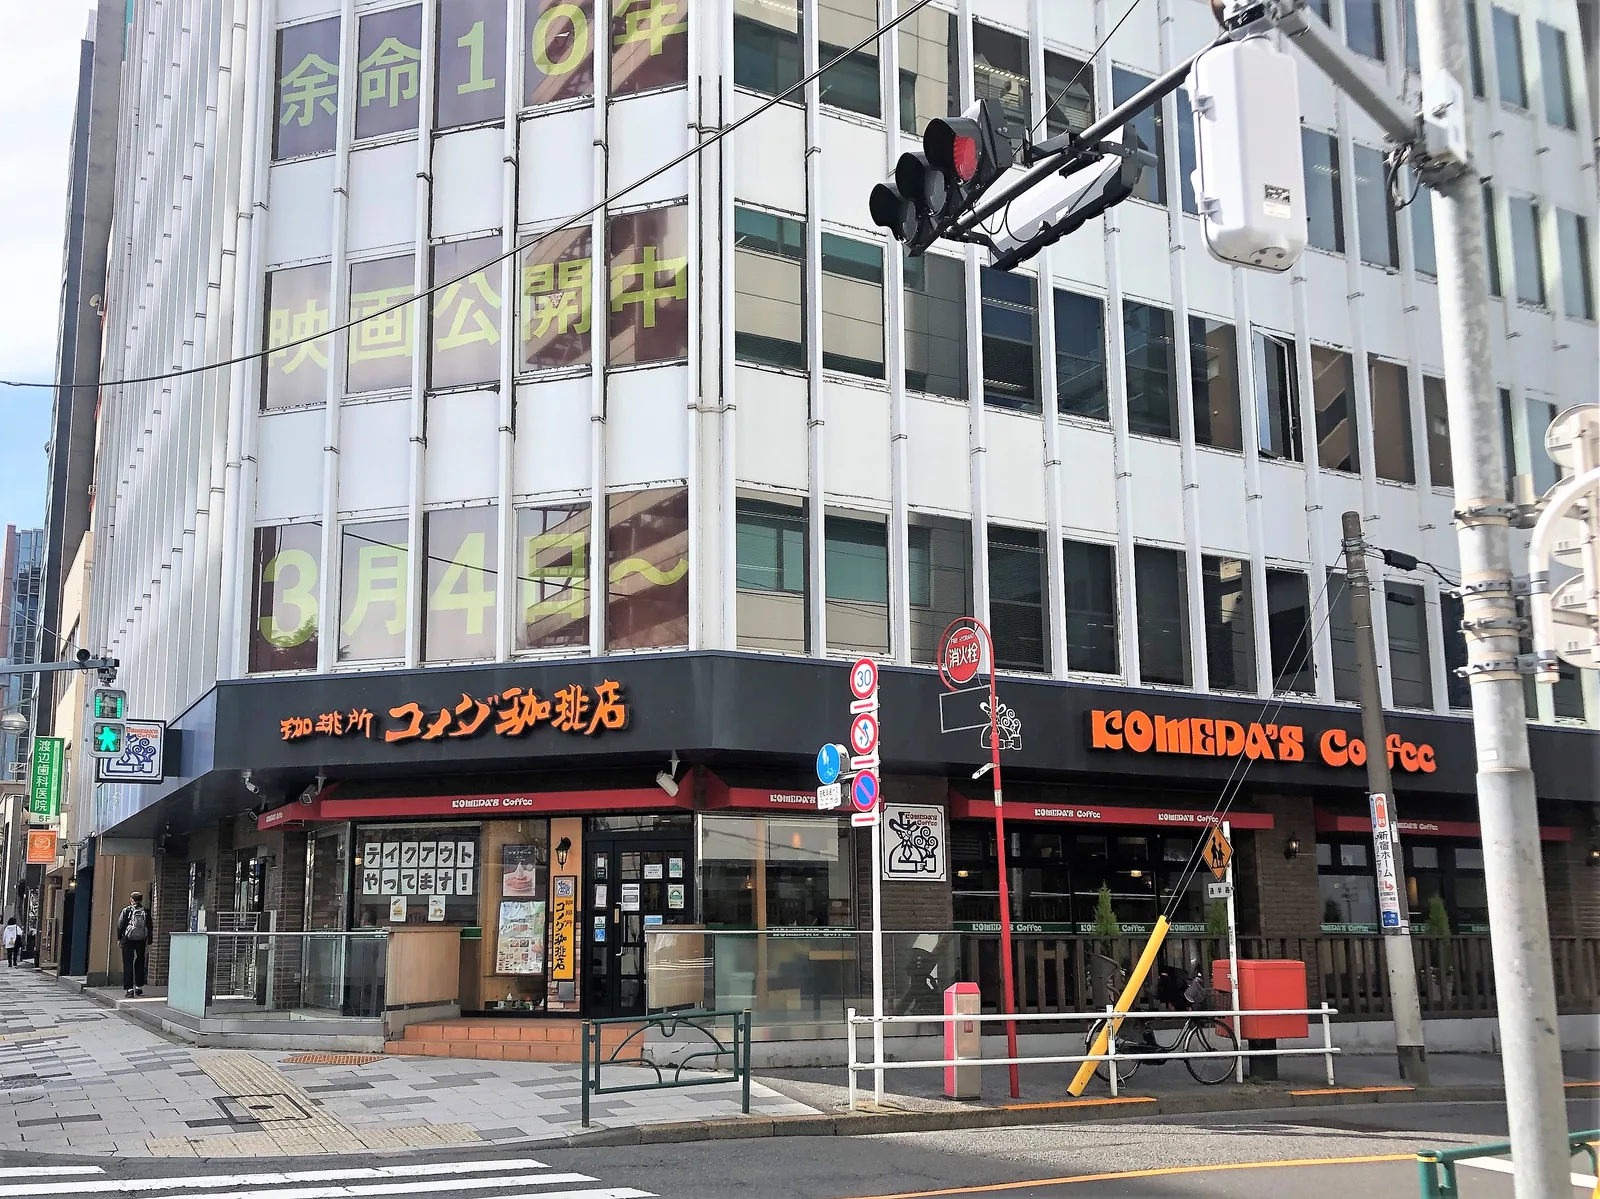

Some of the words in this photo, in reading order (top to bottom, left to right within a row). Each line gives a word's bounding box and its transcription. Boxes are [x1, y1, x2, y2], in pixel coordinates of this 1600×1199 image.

[267, 246, 687, 375] 映画公開中
[949, 642, 979, 669] 消火栓
[856, 669, 872, 688] 30
[280, 708, 375, 742] 珈琲所
[384, 678, 628, 743] コメダ珈琲店
[1091, 710, 1304, 762] KOMEDA'S
[1319, 729, 1437, 773] Cofee
[34, 740, 51, 812] 渡辺歯科医院
[452, 799, 500, 808] KOMEDA'S
[502, 798, 533, 807] Coffee
[769, 794, 816, 804] KOMEDA'S
[38, 815, 51, 823] 5F
[1034, 808, 1074, 818] KOMEDA'S
[1076, 810, 1101, 819] Coffee
[1158, 813, 1195, 822] KOMEDA'S
[365, 846, 473, 865] テイクアウト
[1378, 830, 1393, 878] 新宿ホーム
[364, 872, 469, 892] やってます！
[1016, 923, 1043, 932] Coffee
[1121, 924, 1146, 932] Coffee
